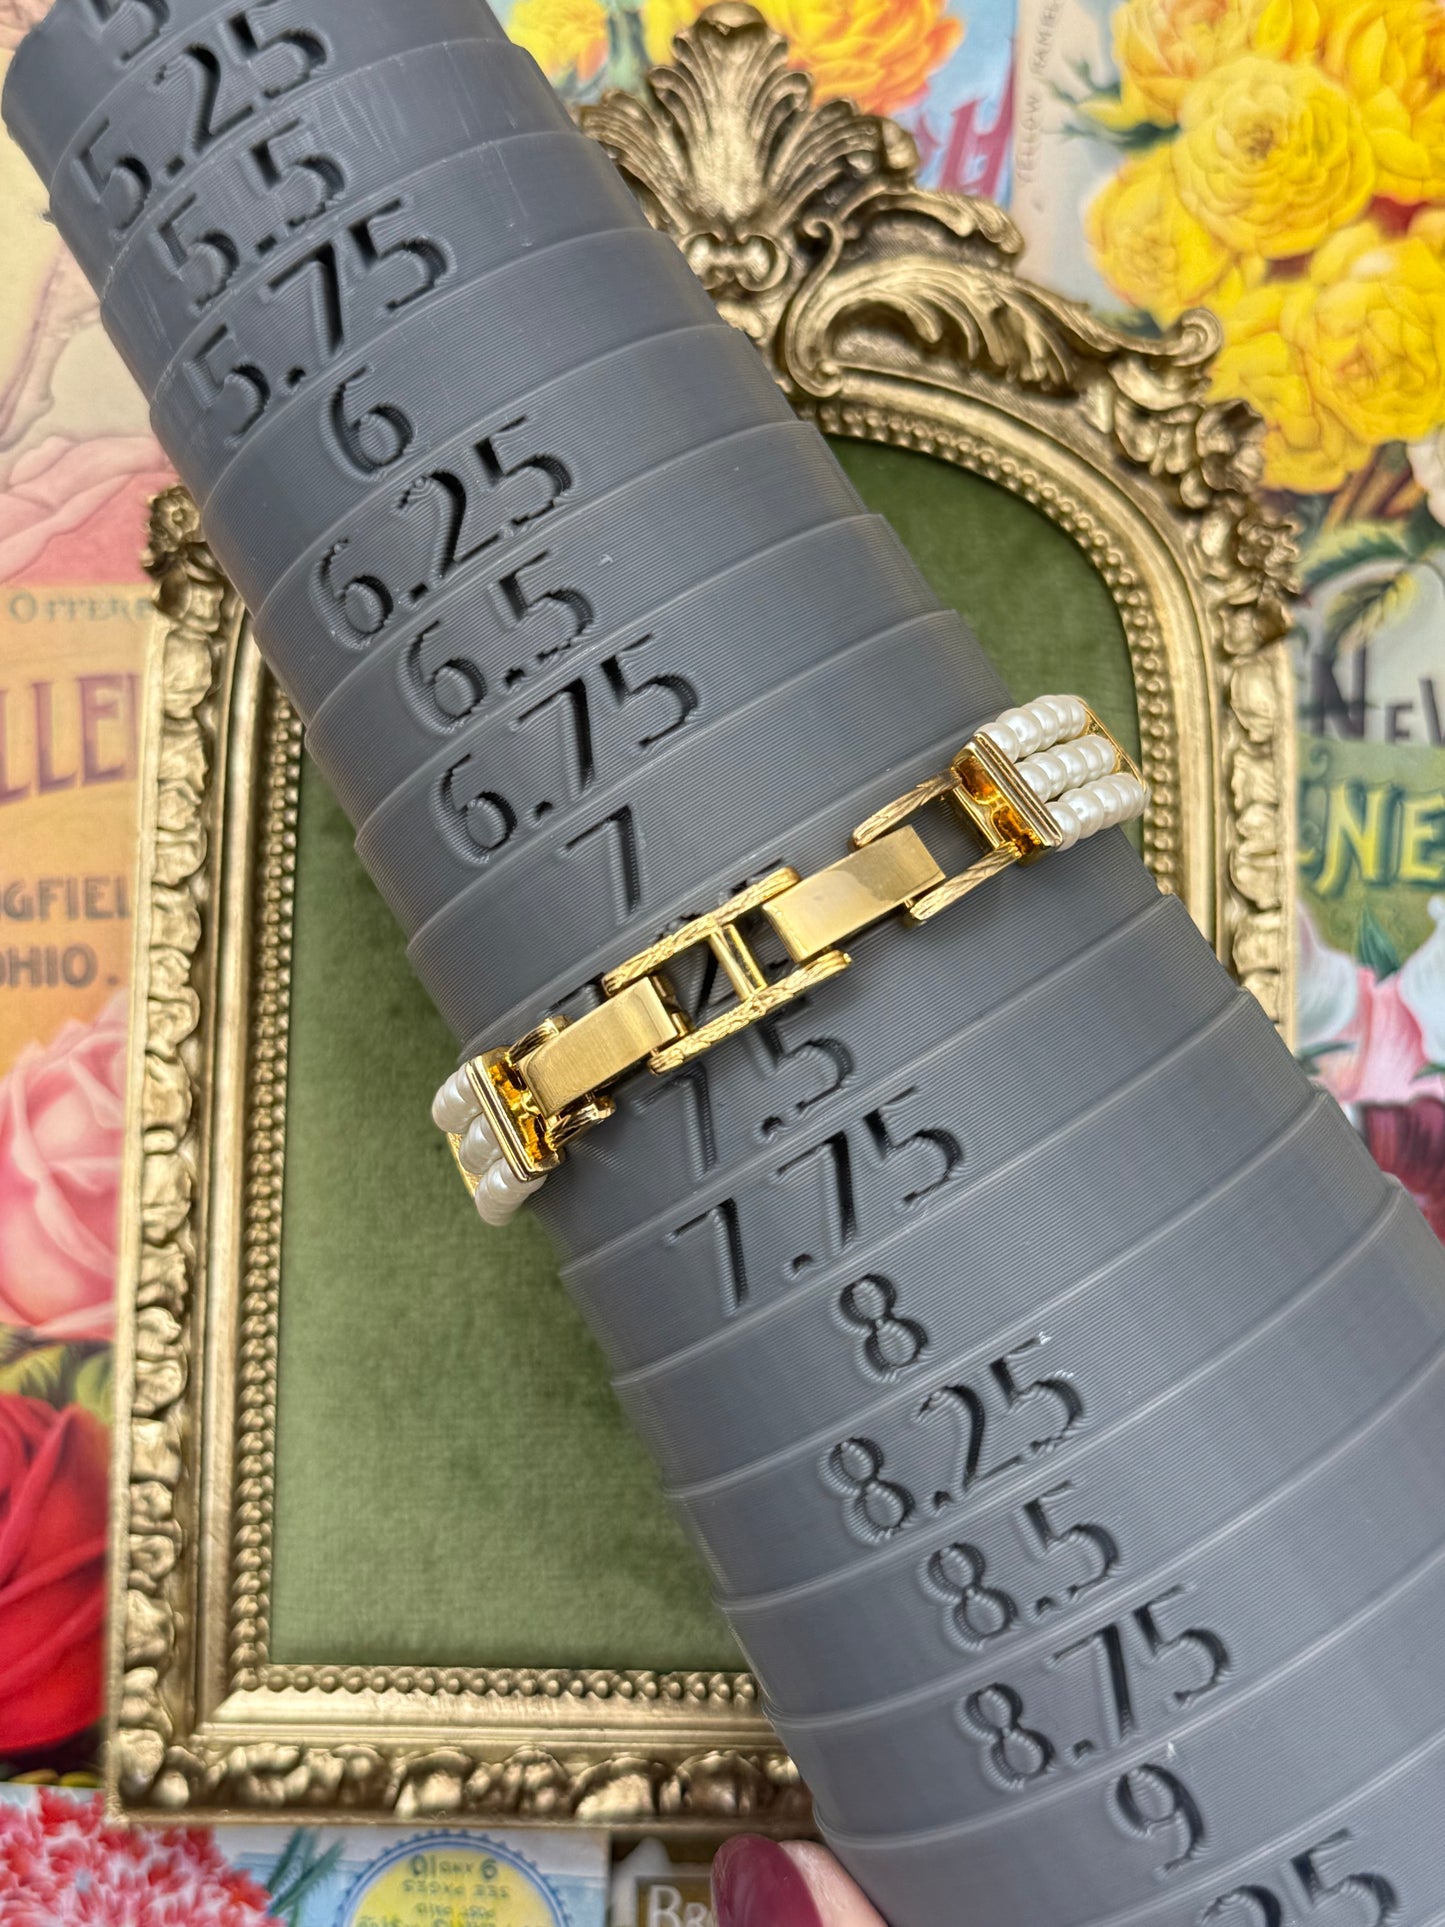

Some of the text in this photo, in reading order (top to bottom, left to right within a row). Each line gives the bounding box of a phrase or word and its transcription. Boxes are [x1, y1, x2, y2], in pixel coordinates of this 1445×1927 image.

[72, 0, 333, 236] 5.25
[152, 118, 346, 312] 5.5
[186, 199, 455, 444] 5.75
[321, 366, 416, 482] 6
[313, 415, 575, 650] 6.25
[403, 552, 596, 735] 6.5
[435, 634, 700, 863] 6.75
[561, 804, 643, 924] 7
[633, 1000, 855, 1180] 7.5
[667, 1086, 964, 1316] 7.75
[835, 1273, 931, 1383] 8
[820, 1332, 1085, 1543] 8.25
[921, 1480, 1122, 1651] 8.5
[958, 1583, 1234, 1789] 8.75
[1110, 1762, 1210, 1878] 9
